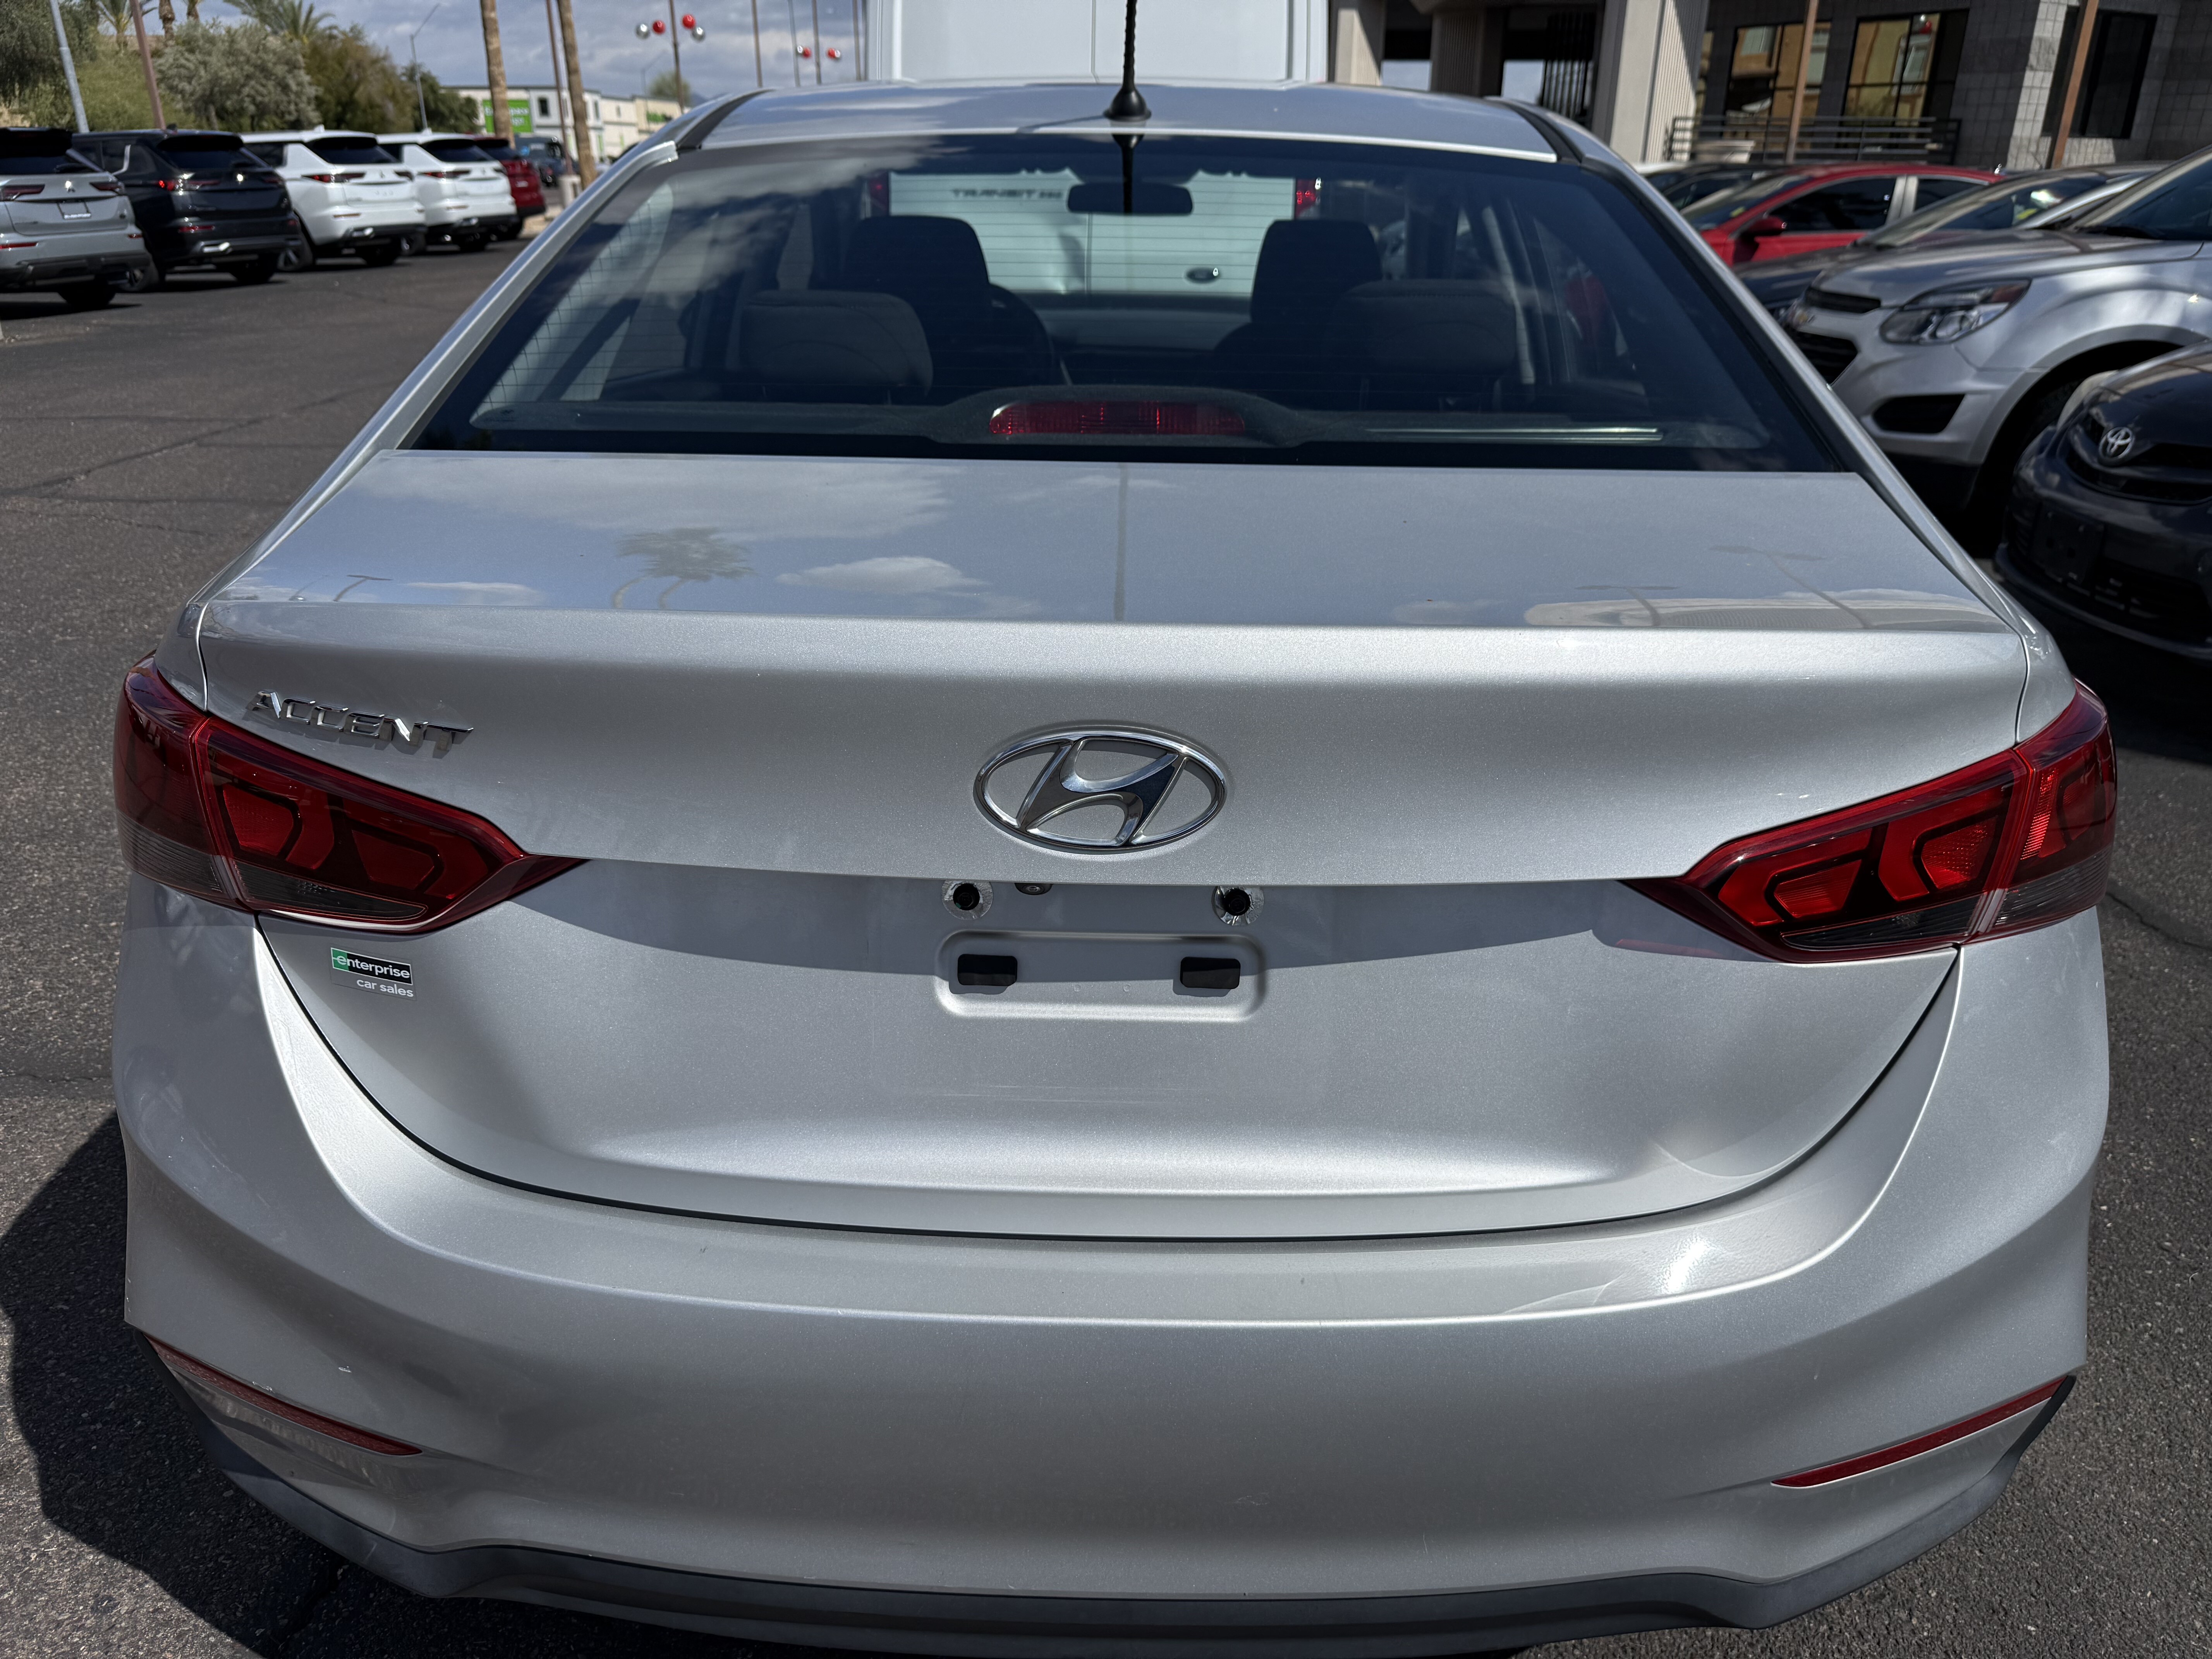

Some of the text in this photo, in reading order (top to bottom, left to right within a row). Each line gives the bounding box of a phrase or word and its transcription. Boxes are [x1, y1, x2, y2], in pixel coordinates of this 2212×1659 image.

[246, 690, 474, 750] ACCENT
[337, 955, 410, 978] enterprise
[357, 979, 414, 997] car sales
